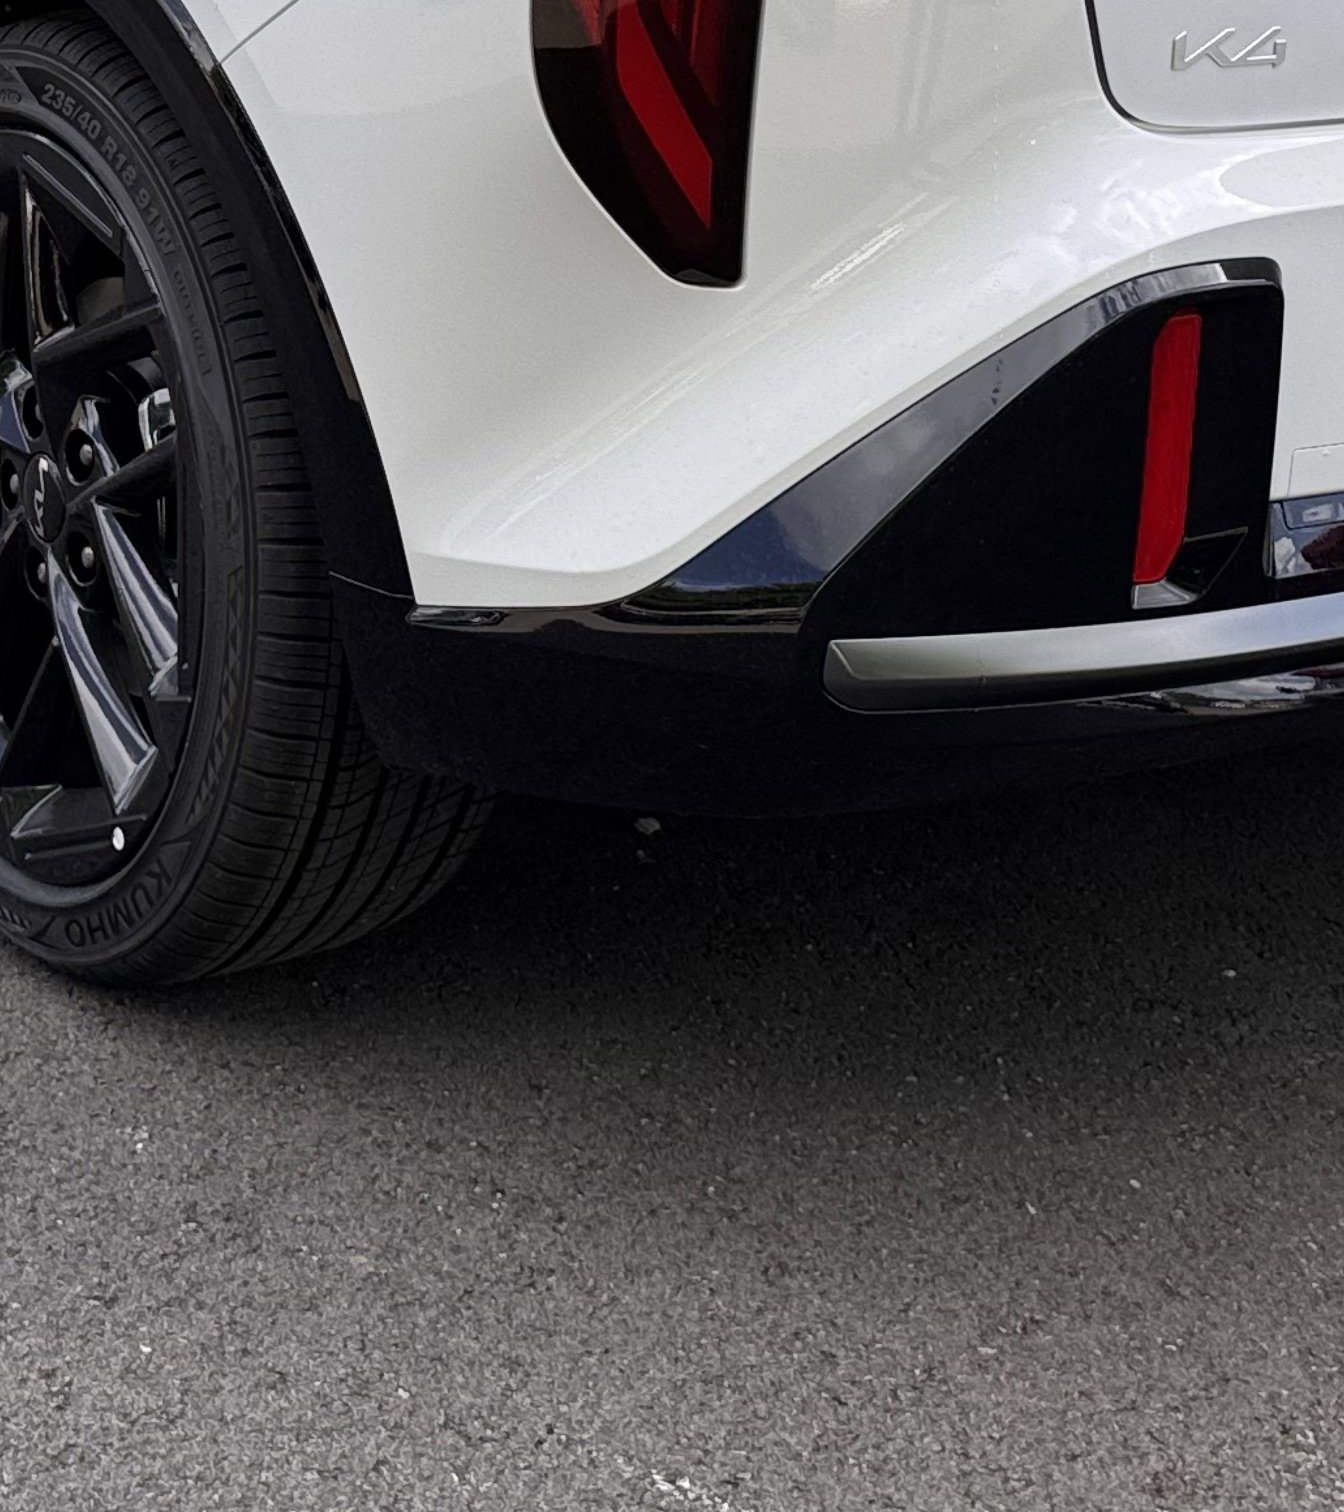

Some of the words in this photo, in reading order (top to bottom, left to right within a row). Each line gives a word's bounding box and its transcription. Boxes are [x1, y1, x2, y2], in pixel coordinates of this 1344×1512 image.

[1170, 25, 1288, 72] K4
[41, 82, 101, 140] 235/40
[100, 137, 138, 192] R18
[64, 855, 173, 948] KUMHO
